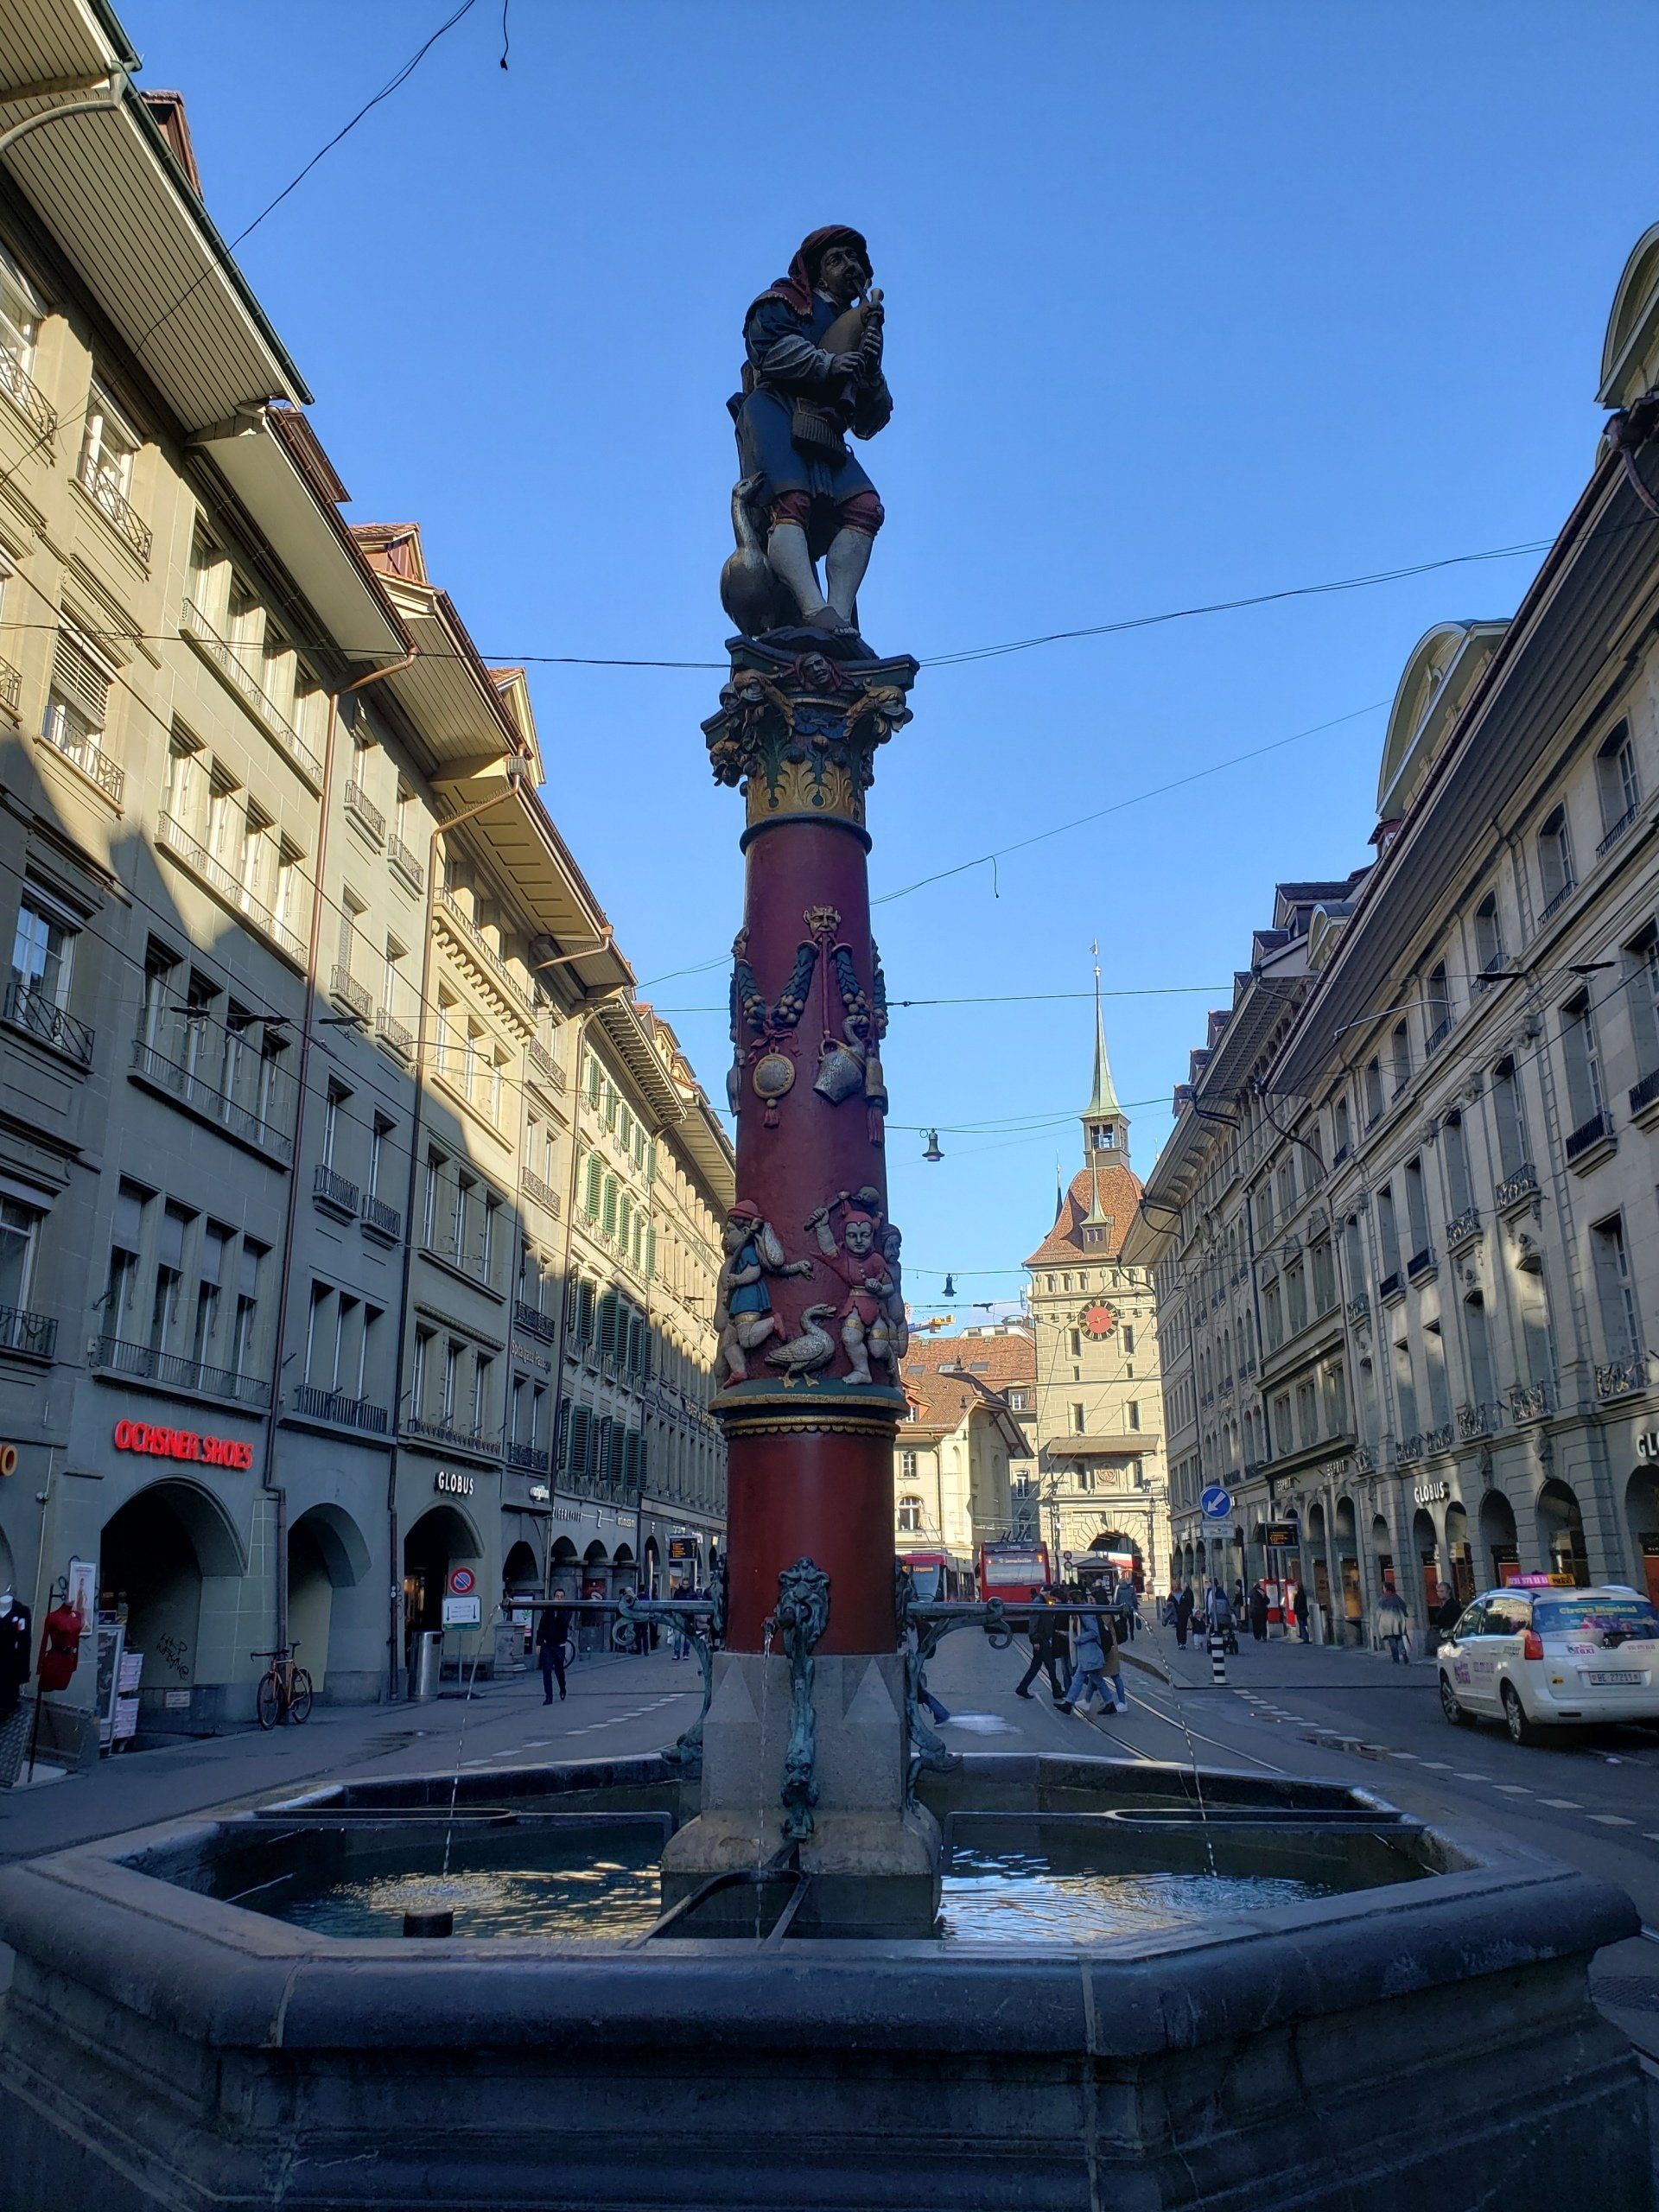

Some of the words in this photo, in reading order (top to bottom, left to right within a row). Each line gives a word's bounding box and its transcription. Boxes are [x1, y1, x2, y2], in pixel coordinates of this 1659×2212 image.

[115, 1419, 200, 1461] OCHSNER
[202, 1435, 253, 1469] SHOES
[1637, 1432, 1659, 1458] GL
[1327, 1459, 1345, 1477] ESPRIT
[438, 1471, 474, 1495] GLOBUS
[1277, 1478, 1292, 1492] ESPRIT
[1414, 1481, 1445, 1503] GLOBUS
[1597, 1674, 1606, 1682] BE
